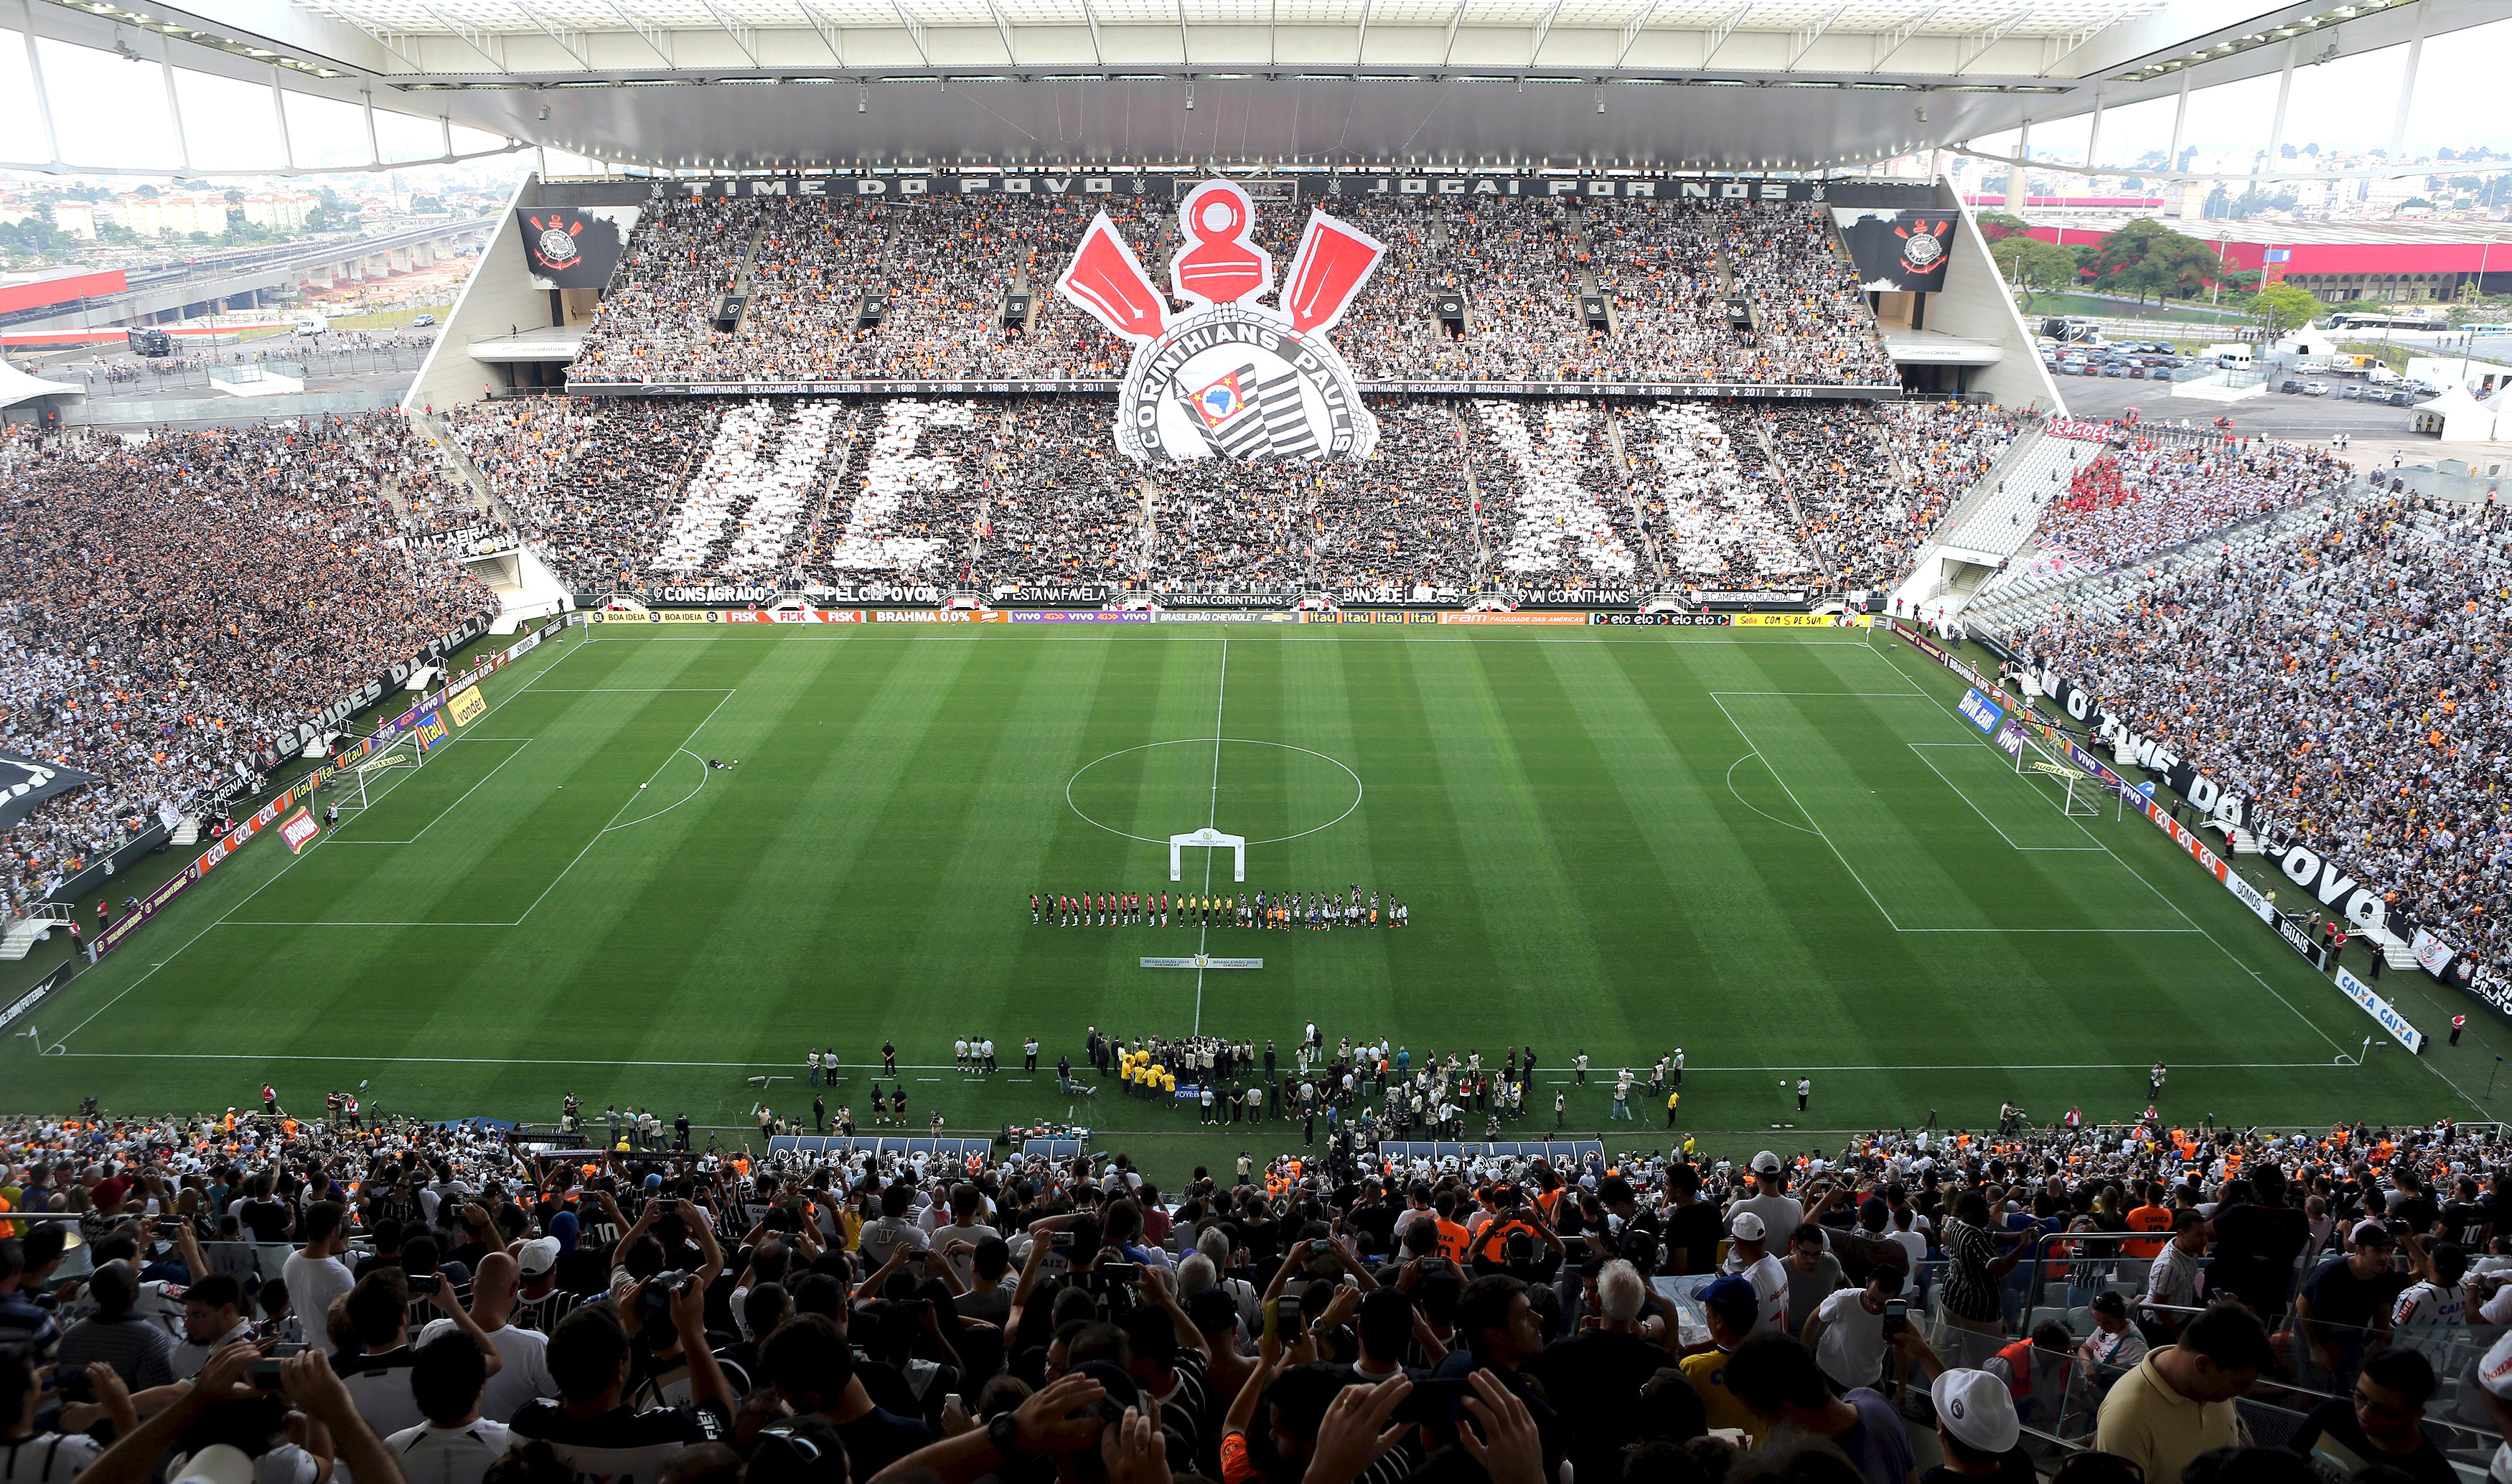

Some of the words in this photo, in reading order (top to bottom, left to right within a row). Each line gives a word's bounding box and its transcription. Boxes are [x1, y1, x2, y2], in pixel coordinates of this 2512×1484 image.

[683, 181, 826, 196] TIME
[857, 179, 927, 194] DO
[960, 178, 1114, 194] POVO
[1367, 179, 1520, 194] JOGAI
[1549, 181, 1654, 197] POR
[689, 385, 743, 395] CORINTHIANS
[747, 383, 809, 394] HEXACAMPEÃO
[813, 384, 861, 393] BRASILEIRO
[896, 383, 917, 393] 1990
[942, 383, 963, 393] 1998
[988, 383, 1009, 393] 1999
[1034, 382, 1056, 393] 2005
[1082, 382, 1105, 392] 2011
[1137, 323, 1280, 449] CORINTHIANS
[1355, 383, 1403, 394] ORINTHIANS
[1408, 382, 1470, 393] HEXACAMPEÃO
[1475, 384, 1523, 394] BRASILEIRO
[1559, 385, 1580, 395] 1990
[1605, 385, 1626, 395] 1998
[1650, 386, 1672, 395] 1999
[1743, 388, 1766, 397] 2011
[665, 586, 765, 602] CONSAGRADO
[1171, 595, 1210, 605] ARENA
[1211, 595, 1283, 605] CORINTHIANS
[1528, 588, 1547, 603] VAI
[1548, 588, 1629, 604] CORINTHIANS
[1756, 593, 1795, 601] MUNDIAL
[731, 611, 759, 622] FISK
[780, 612, 805, 621] FISK
[828, 611, 856, 622] FISK
[876, 611, 937, 622] BRAHMA
[939, 611, 970, 623] 0,0%
[1160, 611, 1212, 621] BRASILEIRÃO
[1213, 613, 1257, 621] CHEVROLET
[1310, 611, 1335, 623] Itaú
[1344, 611, 1369, 623] Itaú
[1377, 612, 1402, 623] Itaú
[1410, 612, 1435, 624] Itaú
[1549, 614, 1584, 624] AMÉRICAS
[1611, 614, 1630, 624] elo
[1634, 614, 1654, 624] elo
[1672, 614, 1692, 625] elo
[1695, 614, 1715, 625] elo
[1765, 616, 1781, 624] COM
[1784, 616, 1791, 624] S
[1794, 616, 1802, 624] DE
[545, 620, 561, 638] IGUAIS
[390, 657, 423, 685] DA
[428, 622, 477, 658] FIEL
[517, 637, 533, 654] SOMOS
[1949, 658, 1975, 684] BRAHMA
[449, 672, 479, 698] BRAHMA
[457, 697, 484, 723] vonder
[2011, 700, 2026, 720] Itaú
[419, 717, 444, 743] Itaú
[293, 777, 312, 801] Itaú
[344, 744, 363, 766] Itaú
[358, 753, 406, 773] uartzolit
[2032, 761, 2085, 781] quartzlit
[214, 779, 244, 802] ARENA
[207, 841, 229, 866] GOL
[233, 821, 255, 846] GOL
[259, 801, 278, 826] GOL
[284, 813, 318, 847] BRAHMA
[2154, 809, 2171, 834] GOL
[2176, 827, 2193, 854] GOL
[2199, 847, 2217, 875] GOL
[2237, 881, 2262, 911] SOMOS
[2280, 919, 2309, 954] IGUAIS
[2342, 976, 2375, 1010] CAIXA
[2379, 1008, 2413, 1045] CAIXA
[594, 1222, 621, 1243] 10
[2460, 1224, 2483, 1244] 10
